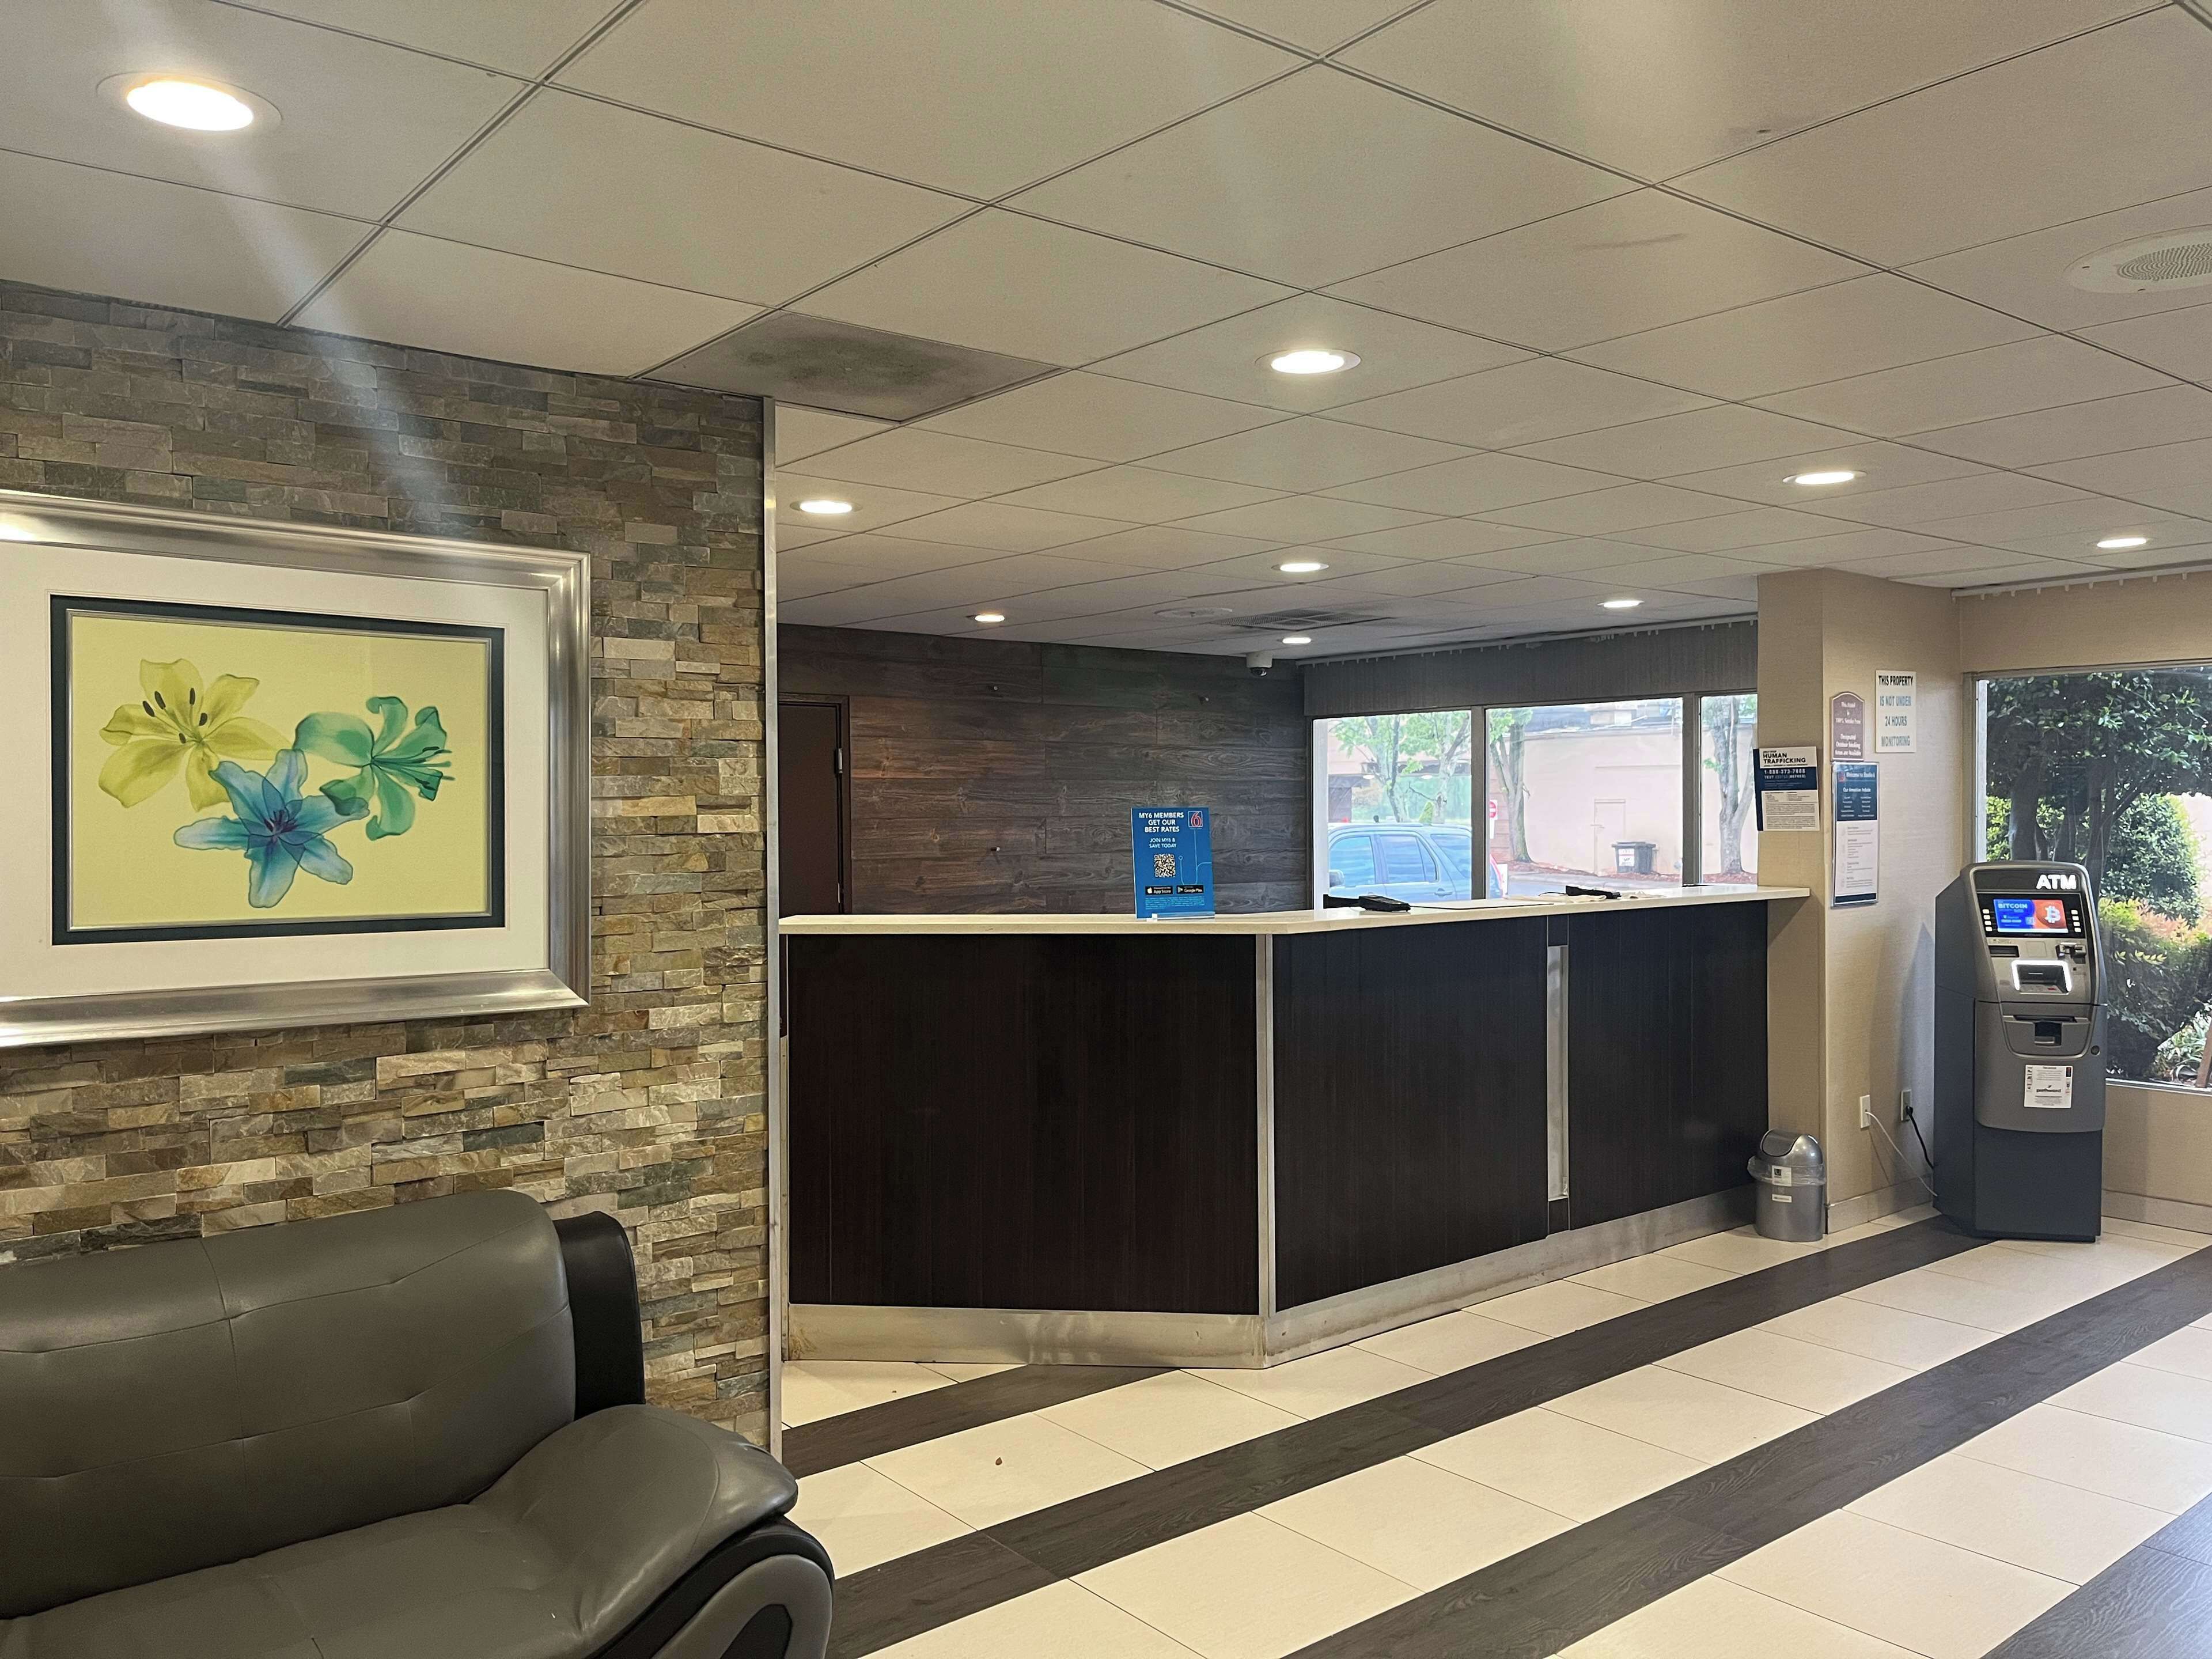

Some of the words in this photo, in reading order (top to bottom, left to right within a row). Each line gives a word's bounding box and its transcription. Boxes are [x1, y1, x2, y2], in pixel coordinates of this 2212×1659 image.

[1878, 675, 1889, 685] THIS
[1890, 676, 1913, 685] PROPERTY
[1880, 695, 1884, 706] IS
[1885, 695, 1895, 706] NOT
[1896, 696, 1911, 706] UNDER
[1885, 715, 1891, 726] 24
[1892, 716, 1907, 726] HOURS
[1881, 736, 1910, 747] MONITORING
[1191, 811, 1202, 827] 6
[2036, 874, 2077, 889] ATM
